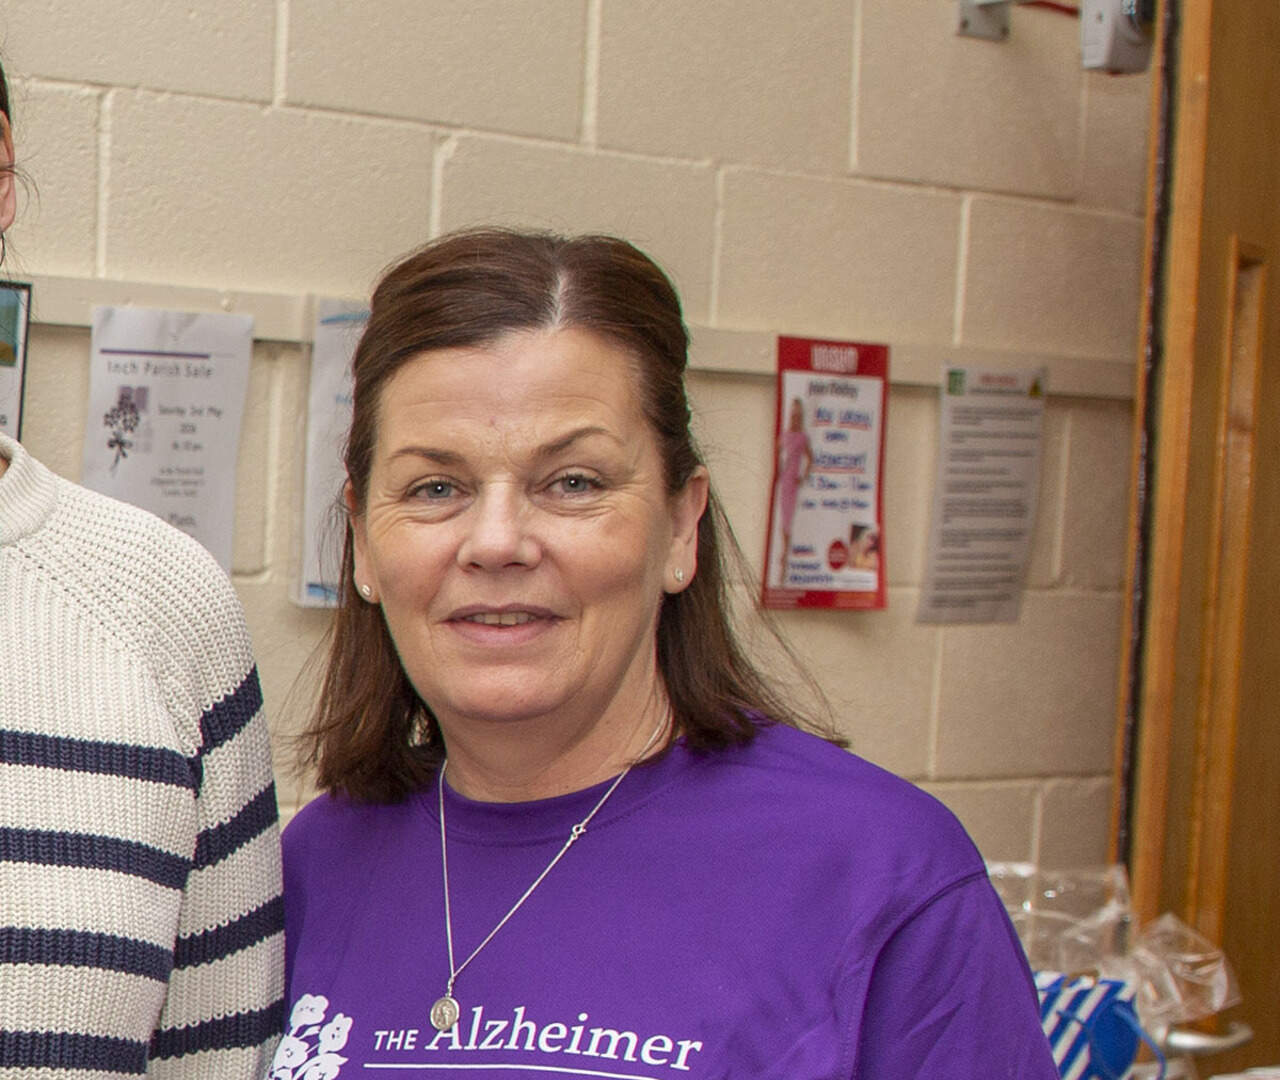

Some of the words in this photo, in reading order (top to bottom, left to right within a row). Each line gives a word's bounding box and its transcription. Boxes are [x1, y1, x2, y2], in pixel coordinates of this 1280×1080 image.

[107, 361, 138, 375] Inch
[144, 362, 180, 377] Parish
[184, 364, 213, 378] Sale
[373, 1029, 419, 1051] THE
[424, 1006, 703, 1071] Alzheimer
